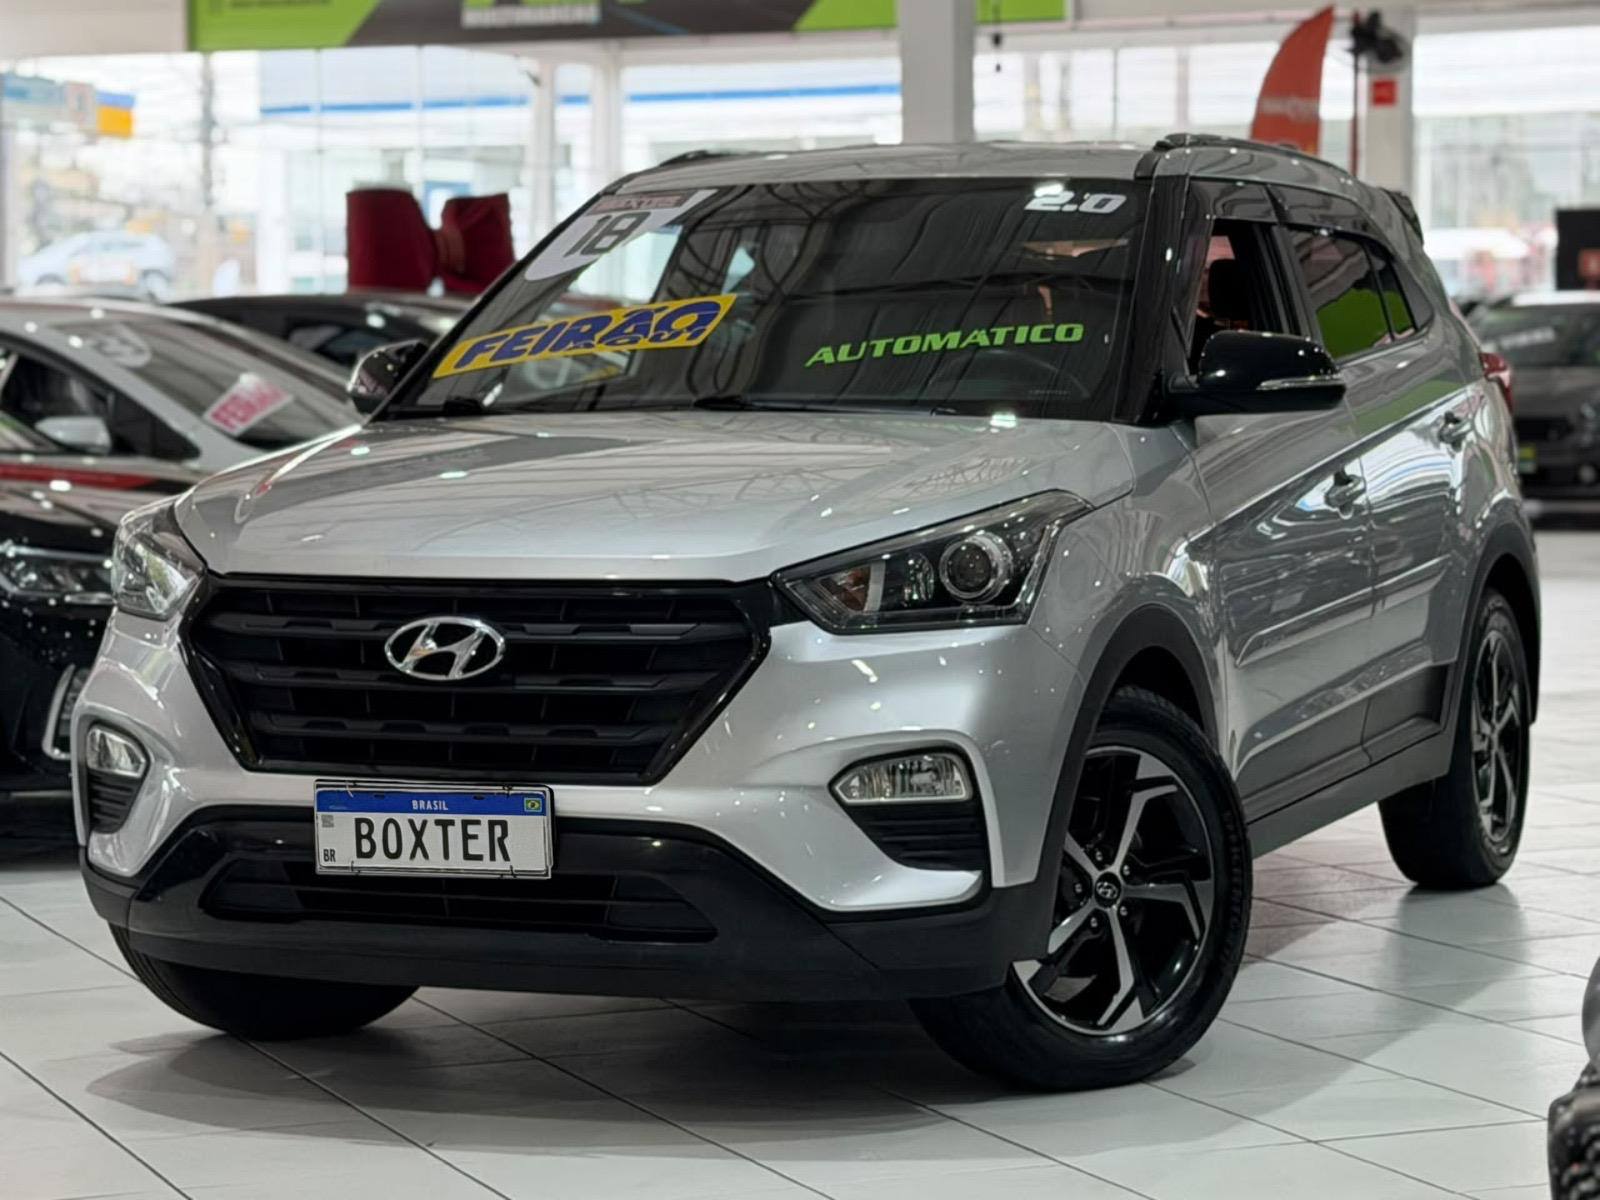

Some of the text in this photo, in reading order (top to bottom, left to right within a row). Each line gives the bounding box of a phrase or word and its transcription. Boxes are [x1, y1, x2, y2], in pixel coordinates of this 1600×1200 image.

[1024, 185, 1127, 214] 2.0
[563, 211, 651, 257] 18
[805, 323, 1084, 367] AUTOMATICO
[411, 799, 449, 811] BRASIL
[323, 848, 336, 863] BR
[354, 817, 511, 862] BOXTER
